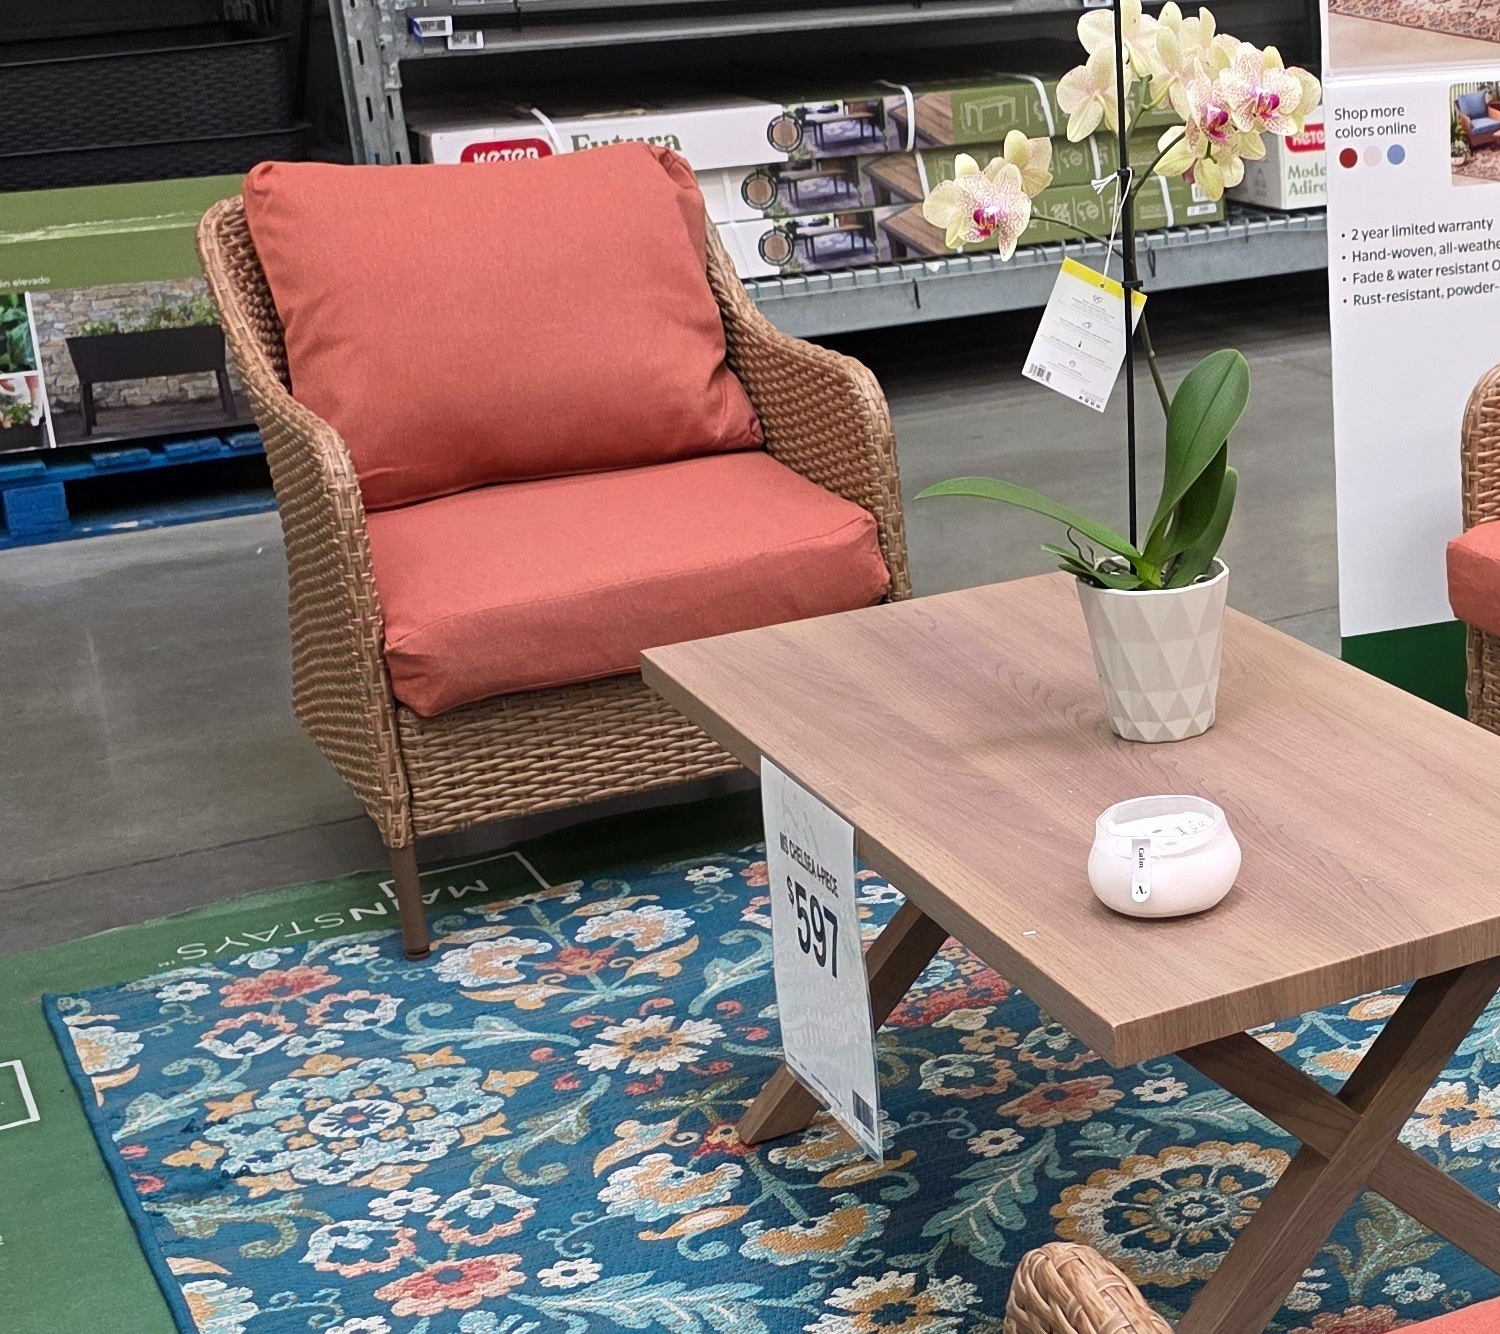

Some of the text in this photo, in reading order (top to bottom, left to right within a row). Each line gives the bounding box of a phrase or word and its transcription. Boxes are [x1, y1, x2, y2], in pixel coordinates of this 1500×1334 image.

[1334, 105, 1405, 121] Shop more
[1335, 121, 1417, 139] colors online
[1351, 218, 1494, 243] 2 year limited warranty
[1352, 245, 1437, 263] Hand-woven,
[1352, 270, 1384, 285] Fade
[1386, 269, 1395, 281] &
[1397, 267, 1434, 280] water
[1435, 261, 1489, 277] resistant
[1353, 286, 1444, 306] Rust-resistant,
[788, 839, 815, 878] CHELSEA
[1138, 847, 1146, 869] Calm
[786, 873, 839, 979] $597
